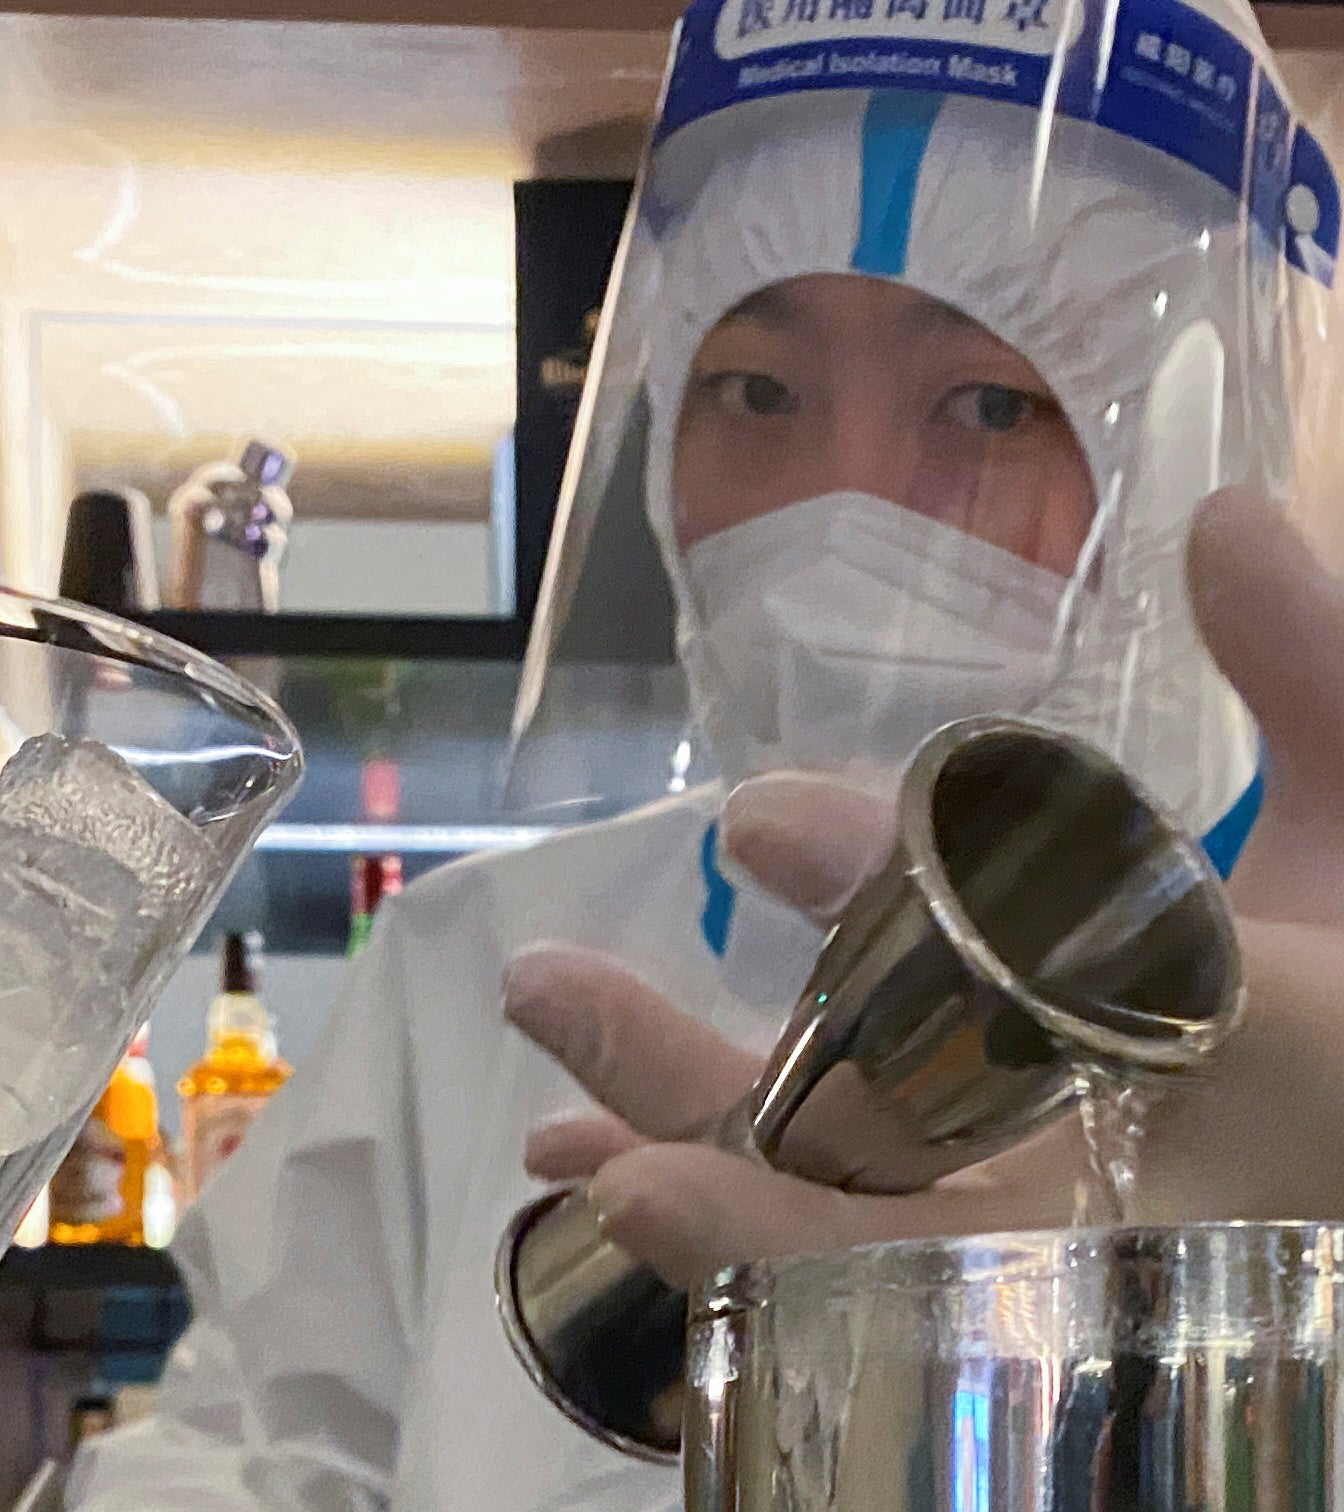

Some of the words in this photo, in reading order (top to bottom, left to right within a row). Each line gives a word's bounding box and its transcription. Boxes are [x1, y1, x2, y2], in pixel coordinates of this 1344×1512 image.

[738, 52, 824, 88] Medical
[829, 52, 941, 77] Isolation
[947, 54, 1018, 87] Mask
